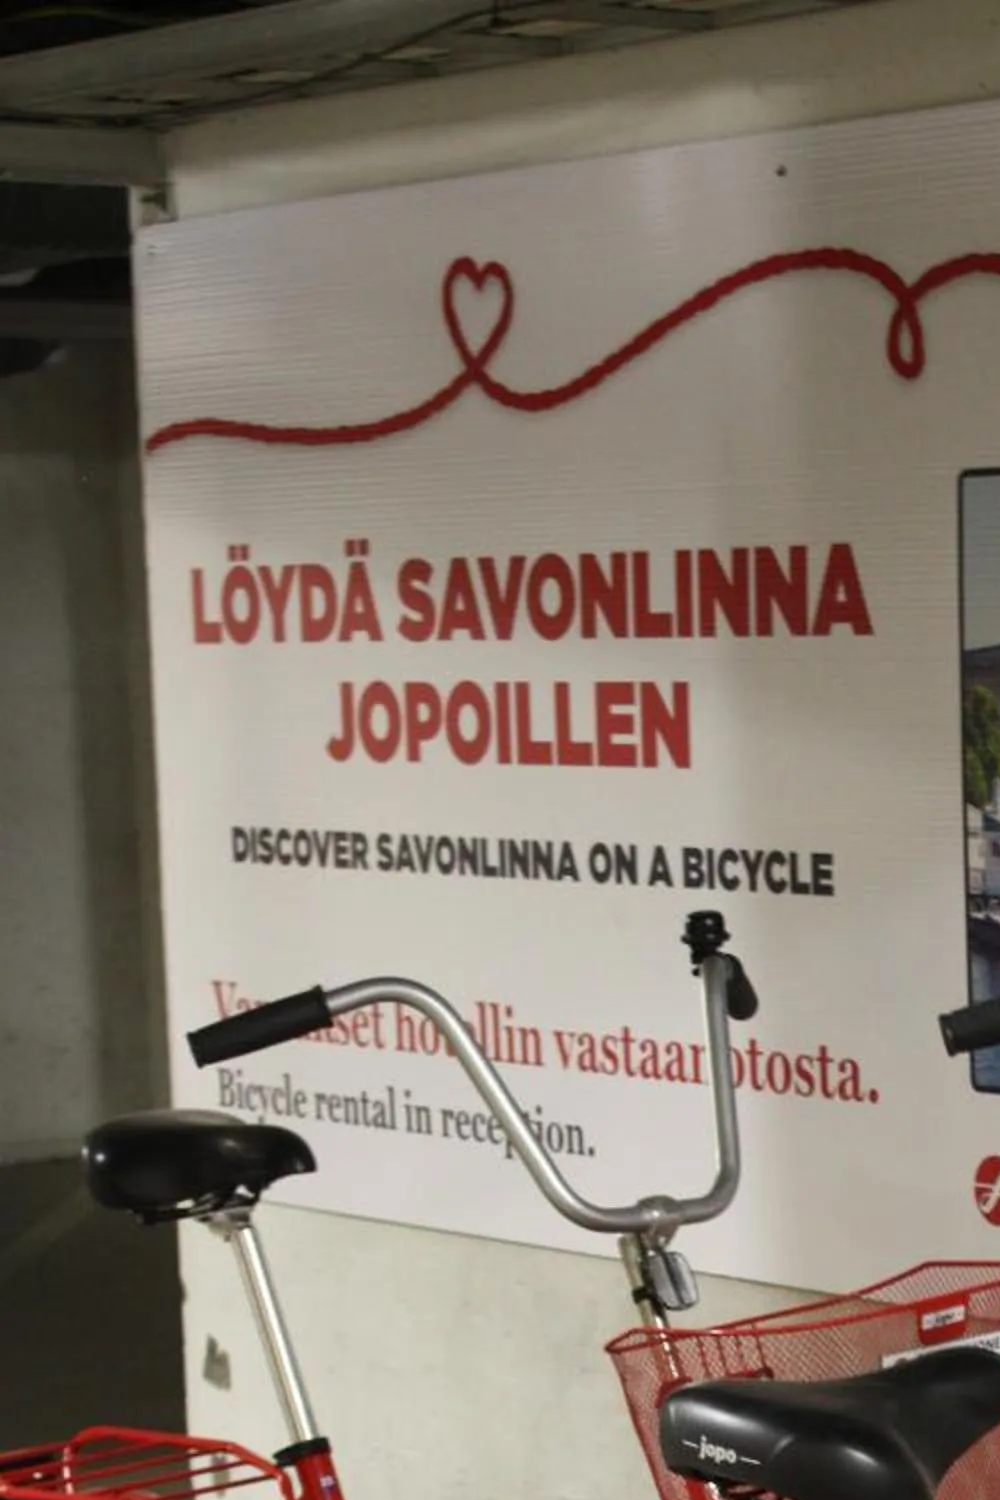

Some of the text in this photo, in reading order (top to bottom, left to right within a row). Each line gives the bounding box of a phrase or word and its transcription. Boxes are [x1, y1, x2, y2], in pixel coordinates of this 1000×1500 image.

[190, 539, 874, 644] LÖYDÄ SAVONLINNA
[326, 680, 691, 769] JOPOILLEN
[231, 826, 835, 896] DISCOVER SAVONLINNA ON A BICYCLE
[217, 1067, 307, 1125] Bicycle
[315, 1085, 397, 1131] rental
[403, 1089, 432, 1135] in
[699, 1434, 737, 1464] jopo
